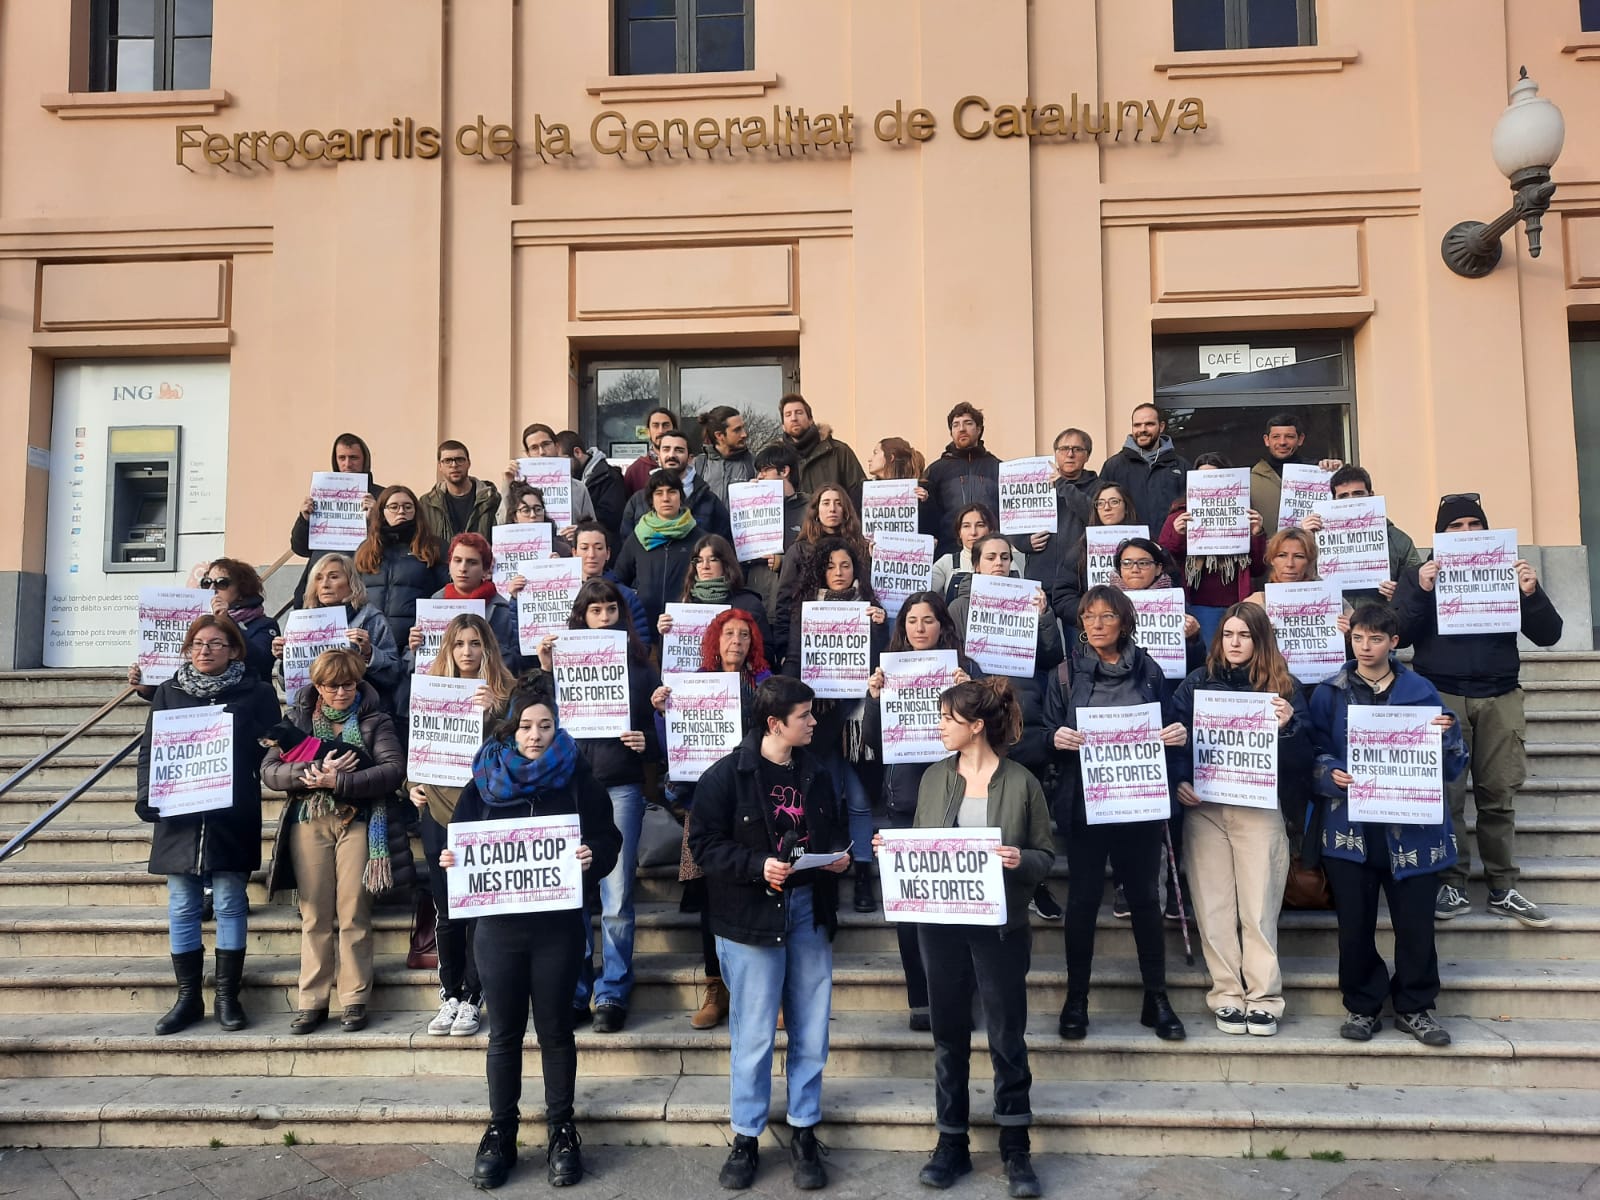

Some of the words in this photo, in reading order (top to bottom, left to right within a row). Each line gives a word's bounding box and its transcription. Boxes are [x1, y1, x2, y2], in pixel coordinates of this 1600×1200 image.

[175, 116, 441, 166] Ferrocarrils
[455, 114, 516, 157] de
[534, 113, 572, 156] la
[590, 104, 855, 156] Generalitat
[873, 99, 938, 143] de
[952, 92, 1208, 143] Catalunya
[1207, 349, 1242, 365] CAFÉ
[1255, 352, 1290, 368] CAFÉ
[112, 385, 153, 401] ING
[1001, 484, 1008, 496] A
[1009, 483, 1034, 496] CADA
[1294, 490, 1308, 500] PER
[1308, 491, 1328, 501] ELLES
[320, 500, 335, 511] MIL
[1002, 496, 1021, 510] MÉS
[1022, 496, 1054, 509] FORTES
[1201, 497, 1215, 507] PER
[1216, 496, 1237, 507] ELLES
[1285, 498, 1298, 508] PER
[738, 510, 752, 520] MIL
[752, 506, 781, 519] MOTIUS
[864, 507, 871, 519] A
[872, 506, 896, 519] CADA
[898, 506, 916, 519] COP
[1191, 508, 1205, 518] PER
[1205, 506, 1245, 517] NOSALTRES
[865, 519, 883, 533] MÉS
[884, 521, 915, 533] FORTES
[1201, 517, 1216, 527] PER
[1216, 516, 1237, 527] TOTES
[1319, 534, 1326, 546] 8
[1327, 532, 1345, 546] MIL
[1347, 529, 1384, 544] MOTIUS
[505, 551, 519, 562] PER
[519, 550, 539, 561] ELLES
[1319, 546, 1332, 556] PER
[1332, 545, 1355, 555] SEGUIR
[1355, 542, 1385, 553] LLUITANT
[1090, 555, 1097, 568] A
[873, 560, 881, 573] A
[883, 560, 909, 576] CADA
[911, 563, 931, 578] COP
[1438, 570, 1446, 584] 8
[1449, 569, 1469, 583] MIL
[1471, 567, 1514, 582] MOTIUS
[874, 574, 894, 590] MÉS
[895, 576, 928, 592] FORTES
[1092, 569, 1110, 584] MÉS
[1440, 584, 1453, 594] PER
[1454, 583, 1480, 594] SEGUIR
[1481, 582, 1515, 593] LLUITANT
[532, 591, 547, 602] PER
[547, 589, 569, 601] ELLES
[522, 602, 537, 613] PER
[537, 599, 574, 612] NOSALTRE
[533, 613, 547, 623] PER
[549, 610, 570, 622] TOTES
[971, 610, 978, 623] 8
[980, 610, 997, 625] MIL
[999, 613, 1035, 629] MOTIUS
[1159, 613, 1183, 629] COP
[1283, 615, 1299, 627] PER
[1301, 614, 1326, 626] ELLES
[154, 619, 171, 631] PER
[969, 623, 982, 634] PER
[982, 624, 1005, 635] SEGUIR
[1005, 627, 1034, 639] LLUITANT
[143, 630, 159, 641] PER
[1141, 631, 1182, 646] FORTES
[1273, 627, 1288, 639] PER
[1289, 626, 1337, 639] NOSALTRES
[154, 641, 170, 653] PER
[679, 635, 693, 646] PER
[804, 634, 812, 648] A
[814, 634, 844, 649] CADA
[846, 634, 868, 649] COP
[1284, 639, 1300, 650] PER
[1301, 637, 1328, 650] TOTES
[285, 647, 291, 660] 8
[292, 645, 309, 659] MIL
[418, 648, 430, 657] PER
[667, 645, 681, 656] PER
[805, 649, 827, 666] MÉS
[828, 652, 866, 666] FORTES
[285, 660, 297, 670] PER
[677, 656, 691, 668] PER
[557, 667, 565, 683] A
[567, 666, 600, 682] CADA
[601, 665, 625, 681] COP
[560, 683, 583, 702] MÉS
[584, 684, 625, 701] FORTES
[898, 688, 915, 700] PER
[916, 686, 941, 700] ELLES
[886, 701, 903, 713] PER
[683, 709, 699, 721] PER
[700, 709, 724, 721] ELLES
[898, 713, 916, 726] PER
[917, 712, 942, 725] TOTES
[413, 714, 420, 729] 8
[422, 715, 441, 730] MIL
[443, 717, 480, 734] MOTIUS
[671, 722, 687, 734] PER
[688, 721, 735, 734] NOSALTRES
[412, 729, 425, 741] PER
[426, 731, 449, 743] SEGUIR
[449, 733, 480, 745] LLUITANT
[683, 734, 699, 746] PER
[700, 734, 725, 746] TOTES
[1196, 729, 1205, 745] A
[1208, 729, 1245, 747] CADA
[1248, 731, 1275, 750] COP
[154, 746, 164, 762] A
[167, 743, 203, 761] CADA
[205, 737, 230, 756] COP
[1084, 746, 1094, 763] A
[1095, 744, 1133, 763] CADA
[1134, 742, 1161, 760] COP
[1198, 746, 1225, 765] MÉS
[1227, 750, 1273, 770] FORTES
[1352, 748, 1360, 762] 8
[1363, 748, 1387, 764] MIL
[1389, 749, 1437, 766] MOTIUS
[155, 761, 183, 781] MÉS
[184, 757, 228, 779] FORTES
[1086, 763, 1114, 784] MÉS
[1116, 763, 1162, 783] FORTES
[1351, 763, 1367, 776] PER
[1368, 764, 1398, 776] SEGUIR
[1398, 765, 1438, 778] LLUITANT
[463, 844, 476, 868] A
[480, 839, 528, 866] CADA
[532, 837, 567, 862] COP
[894, 850, 905, 873] A
[908, 850, 953, 873] CADA
[955, 850, 989, 874] COP
[468, 867, 501, 894] MÉS
[505, 866, 562, 891] FORTES
[899, 874, 930, 900] MÉS
[931, 879, 986, 901] FORTES
